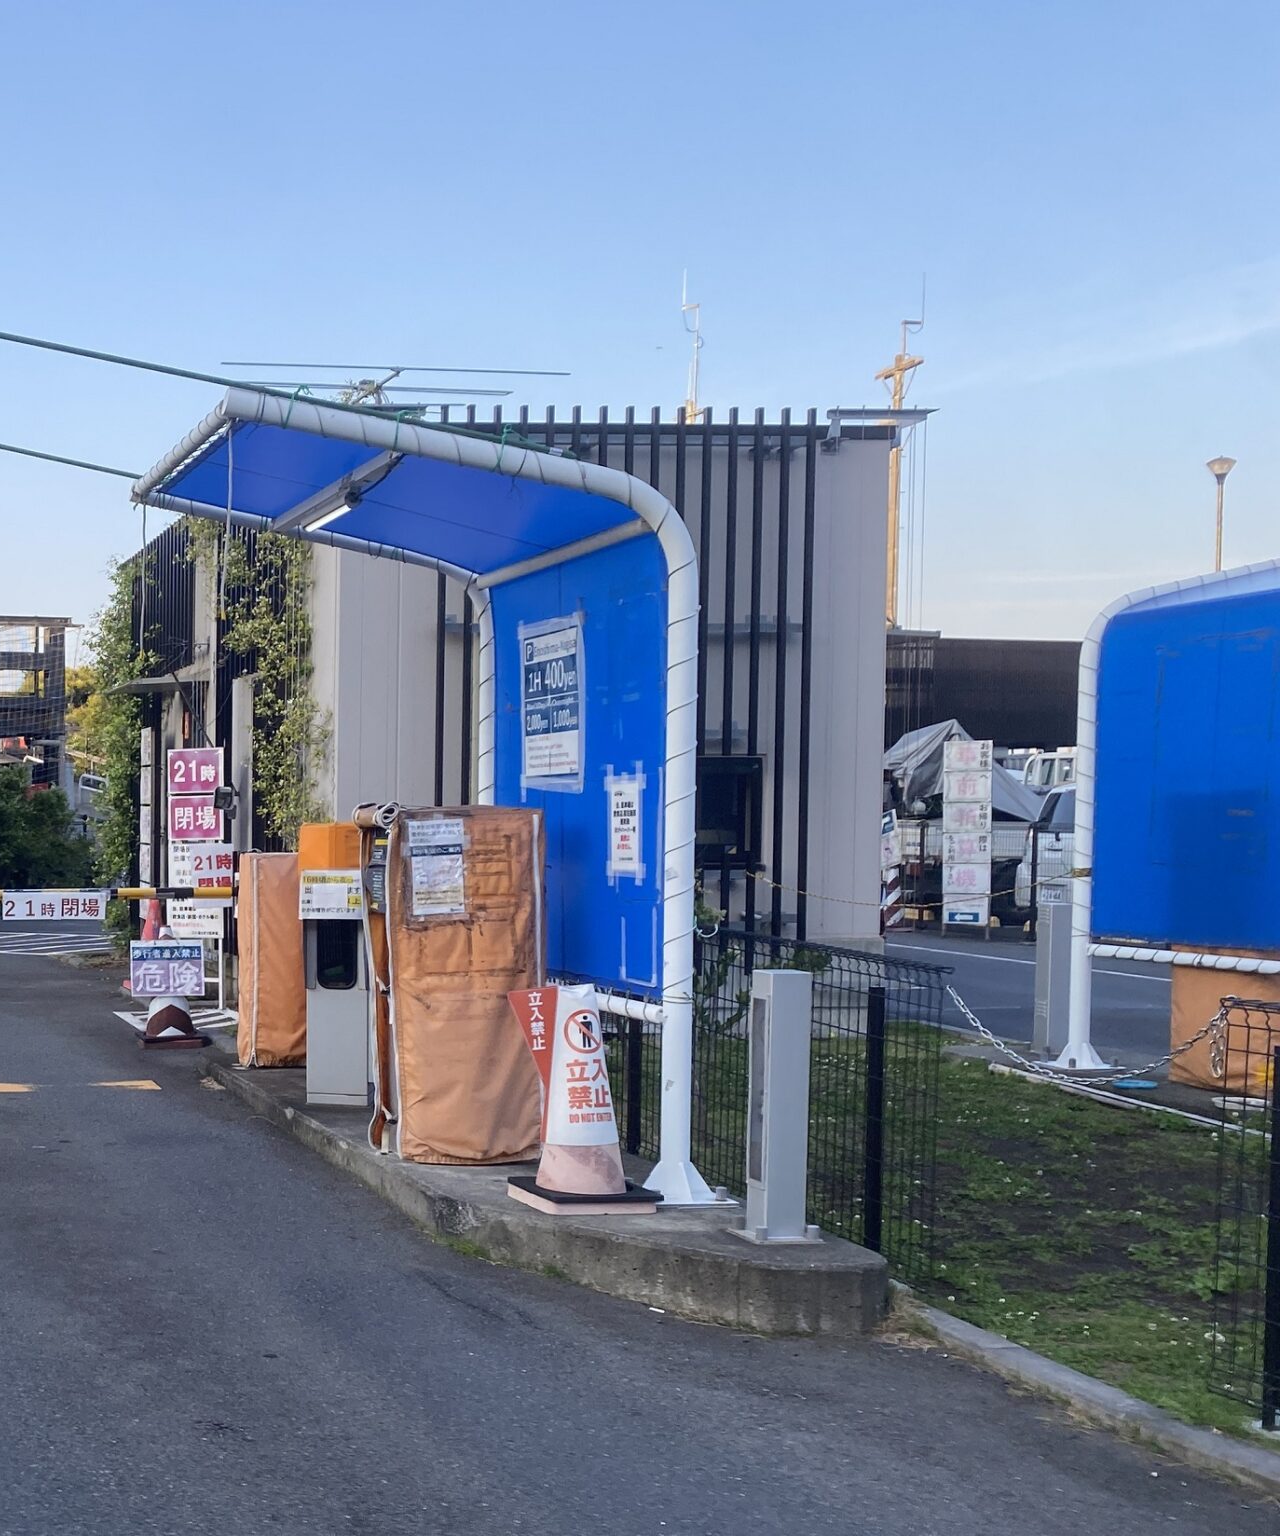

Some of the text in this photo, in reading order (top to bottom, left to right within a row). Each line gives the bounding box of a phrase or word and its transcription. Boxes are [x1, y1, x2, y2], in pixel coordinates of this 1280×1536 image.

[529, 660, 576, 692] 1H 400yen
[174, 760, 216, 783] 21時
[174, 806, 217, 831] 閉場
[194, 854, 232, 871] 21時
[4, 898, 100, 918] 21時閉場
[134, 961, 201, 994] 危険
[528, 991, 547, 1051] 立入禁止
[566, 1058, 607, 1083] 立入
[568, 1085, 611, 1110] 禁止
[569, 1112, 612, 1124] DO NOT ENTER
